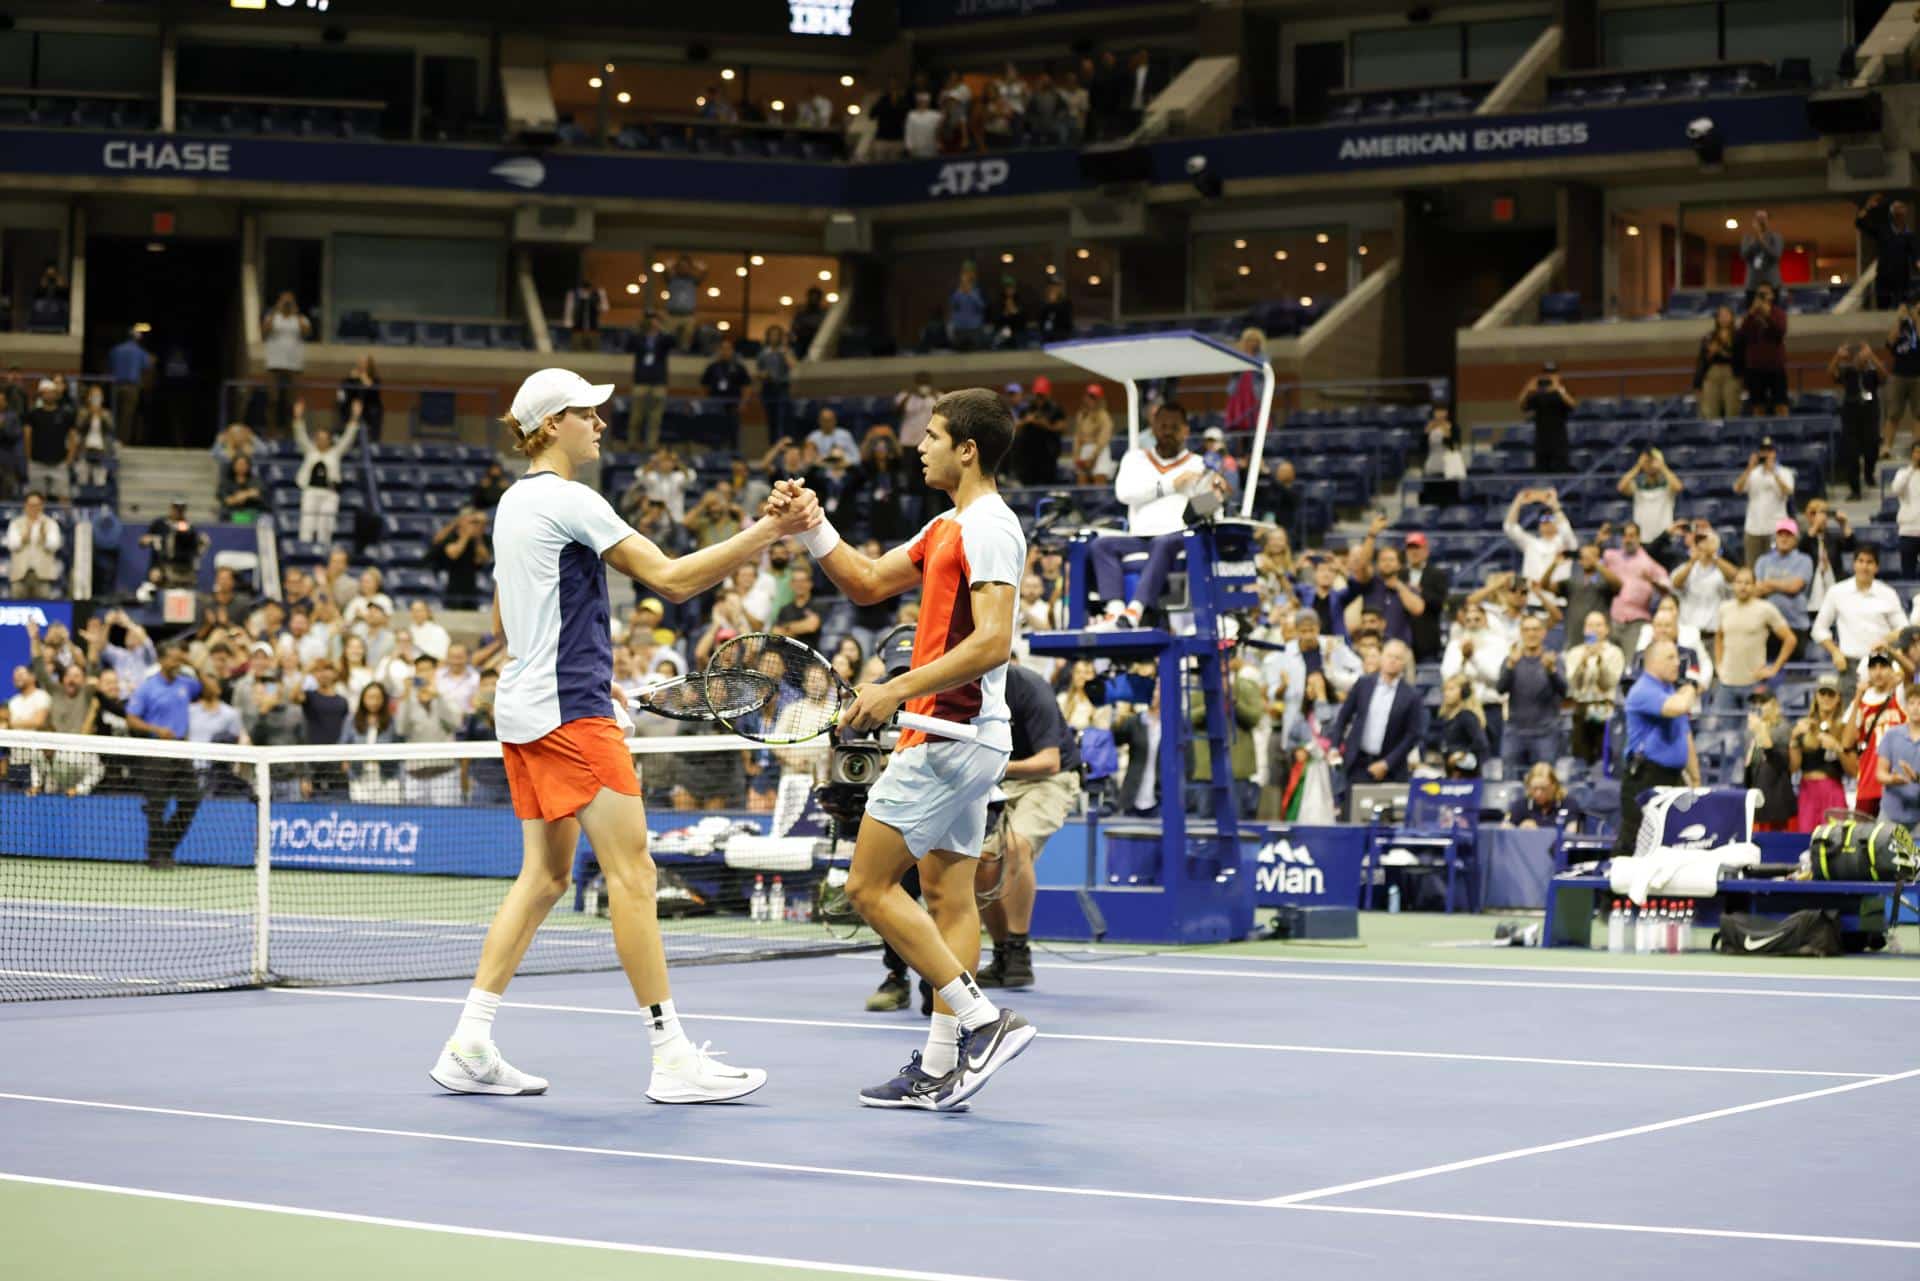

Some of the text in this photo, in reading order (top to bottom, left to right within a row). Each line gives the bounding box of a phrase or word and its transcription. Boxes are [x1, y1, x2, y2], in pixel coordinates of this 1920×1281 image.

[789, 7, 852, 36] IBM
[104, 141, 231, 171] CHASE
[1339, 122, 1589, 160] AMERICAN EXPRESS
[930, 160, 1009, 195] ATP
